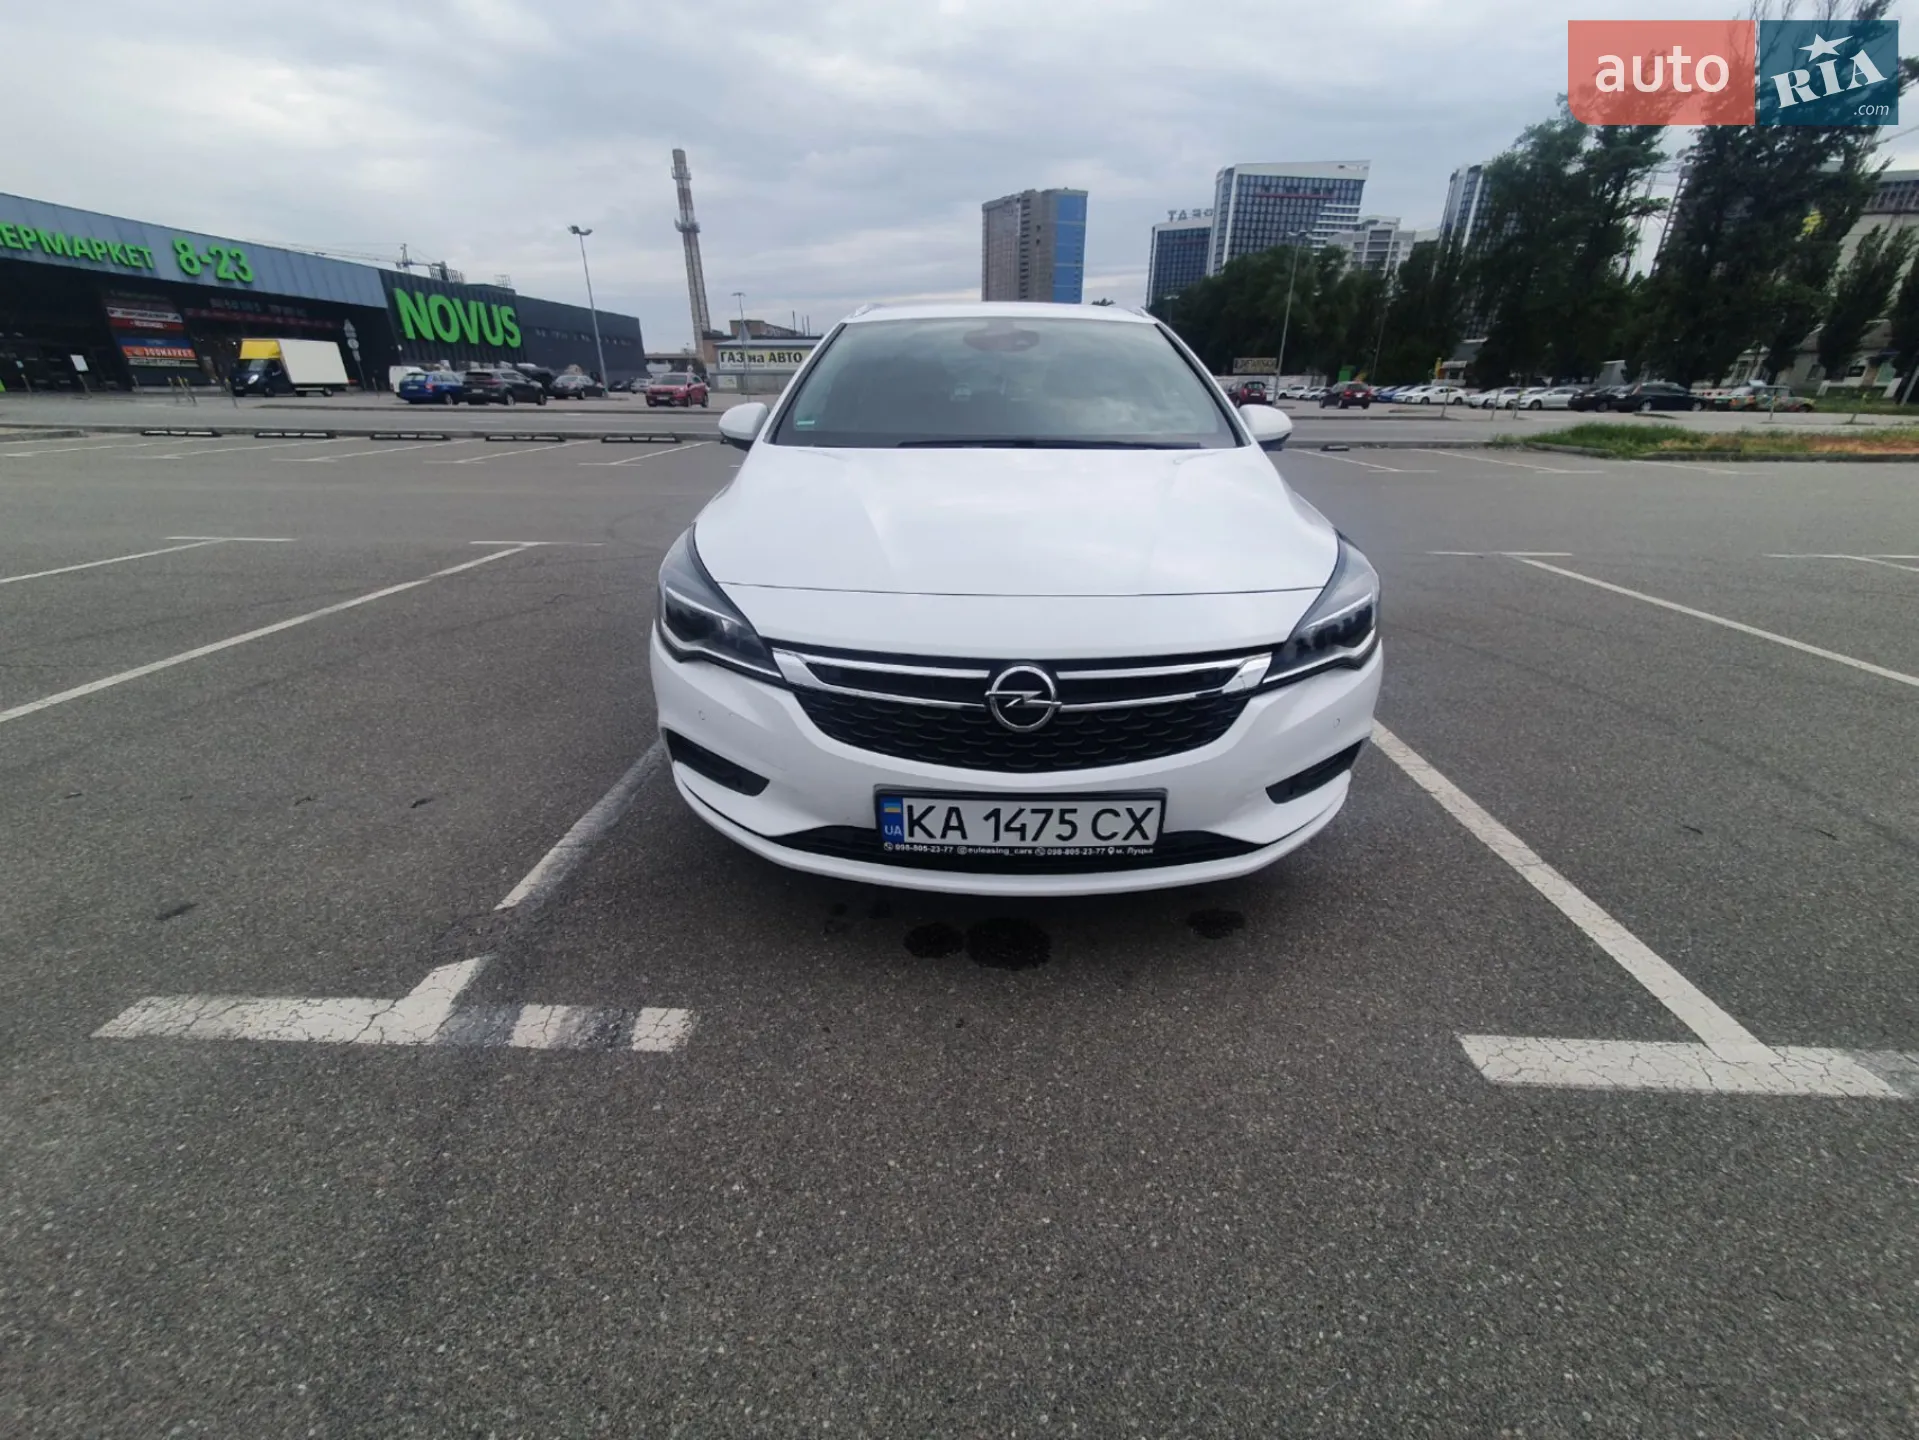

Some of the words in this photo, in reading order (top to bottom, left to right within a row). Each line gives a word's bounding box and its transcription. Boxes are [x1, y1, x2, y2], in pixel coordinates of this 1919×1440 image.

[0, 222, 154, 270] ЕРМАРКЕТ
[172, 237, 254, 283] 8-23
[394, 287, 522, 348] NOVUS
[720, 351, 745, 364] ГАЗ
[748, 354, 765, 364] на
[768, 351, 803, 364] АВТО
[884, 825, 903, 837] UA
[906, 804, 968, 840] KA
[983, 806, 1079, 842] 1475
[1090, 807, 1154, 841] CX
